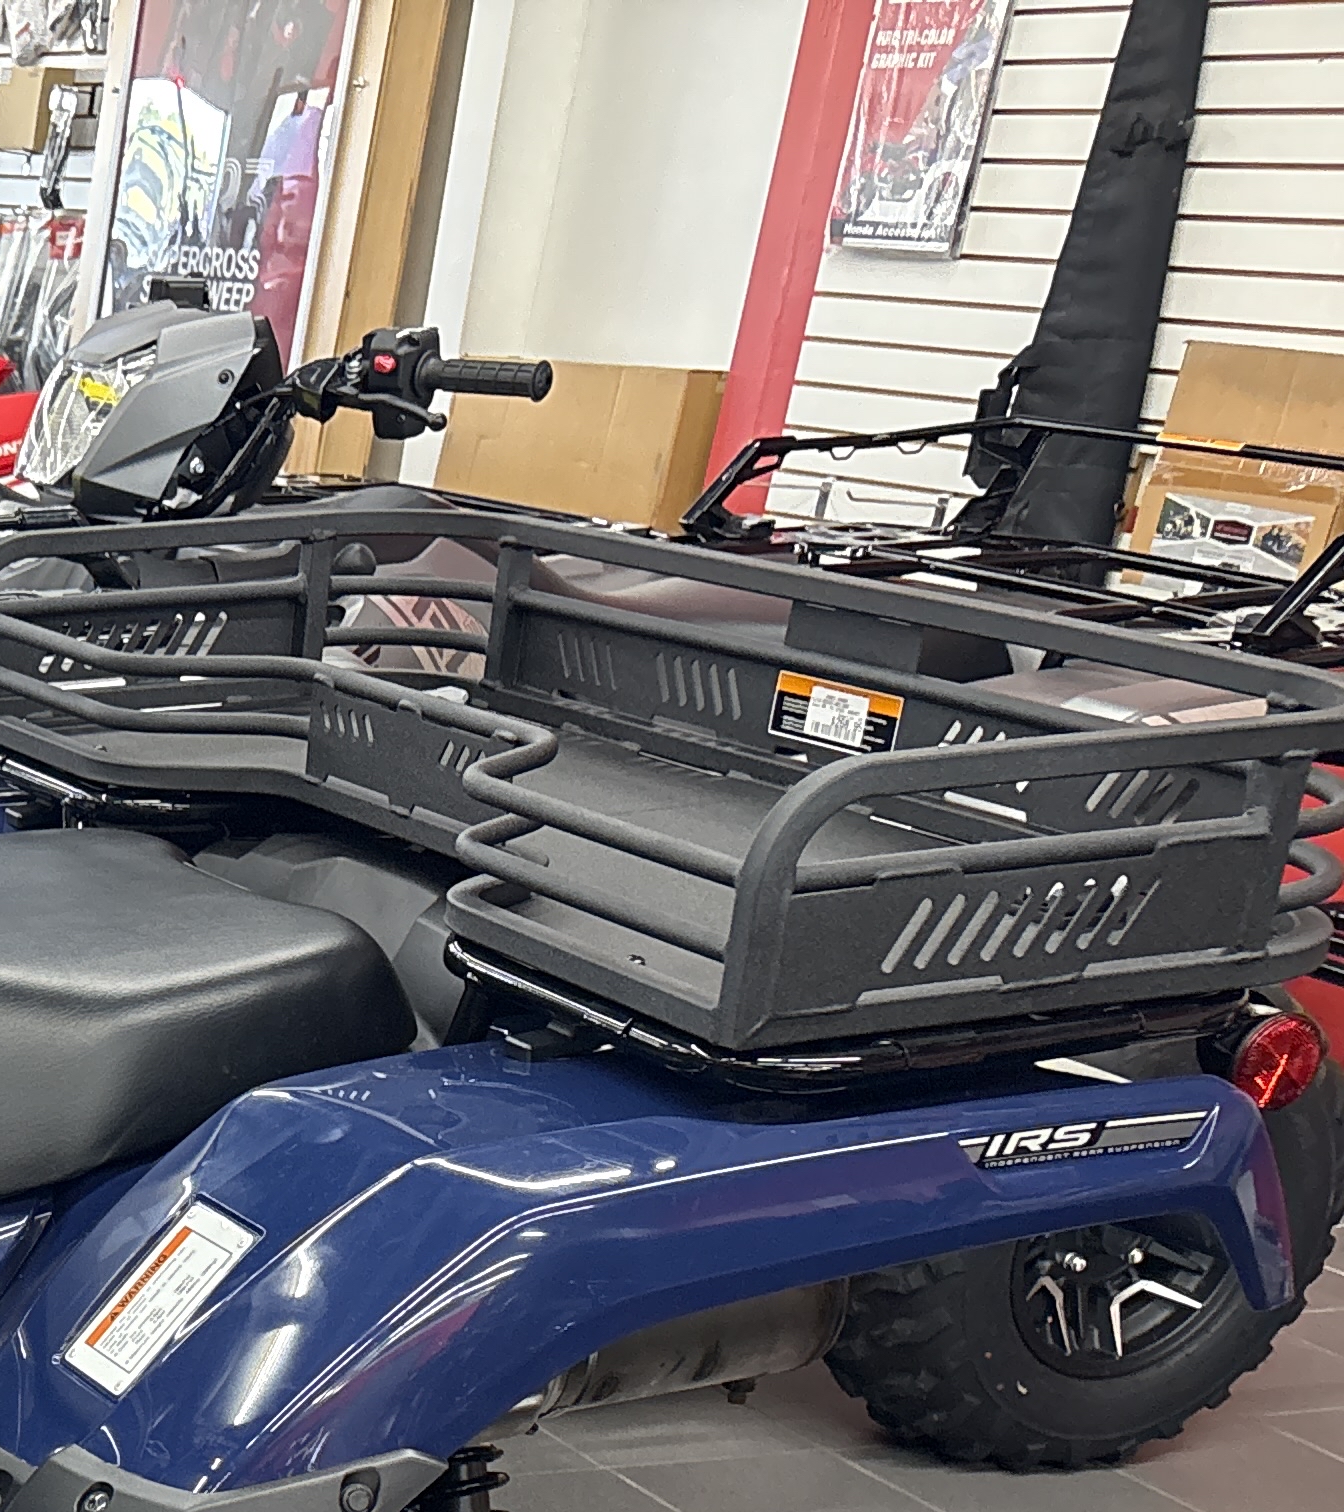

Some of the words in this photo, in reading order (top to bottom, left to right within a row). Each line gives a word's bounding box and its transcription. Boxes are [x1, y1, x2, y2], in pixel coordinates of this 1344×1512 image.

[871, 52, 917, 69] GRAPHIC
[917, 51, 937, 68] KIT
[985, 1122, 1098, 1158] IRS
[117, 1253, 168, 1309] WARNING
